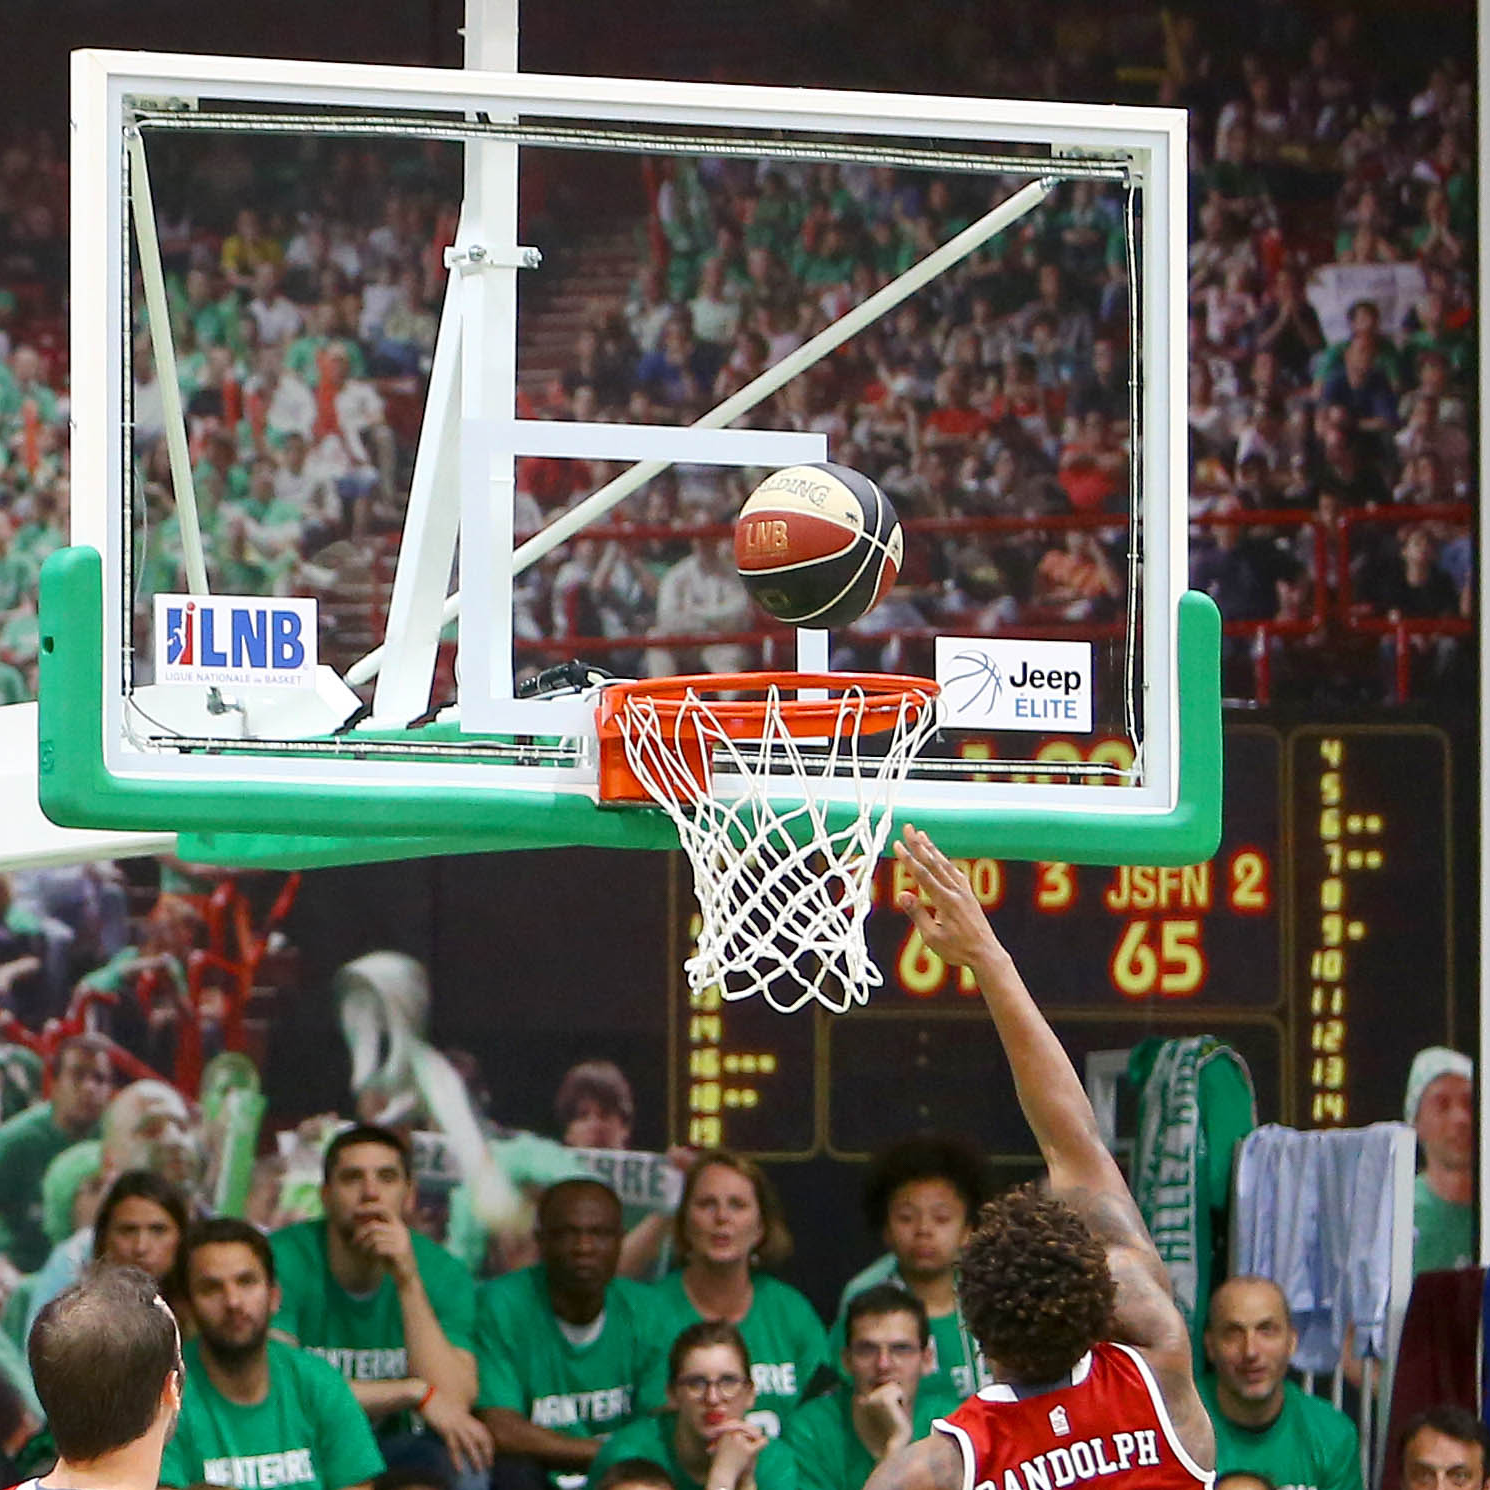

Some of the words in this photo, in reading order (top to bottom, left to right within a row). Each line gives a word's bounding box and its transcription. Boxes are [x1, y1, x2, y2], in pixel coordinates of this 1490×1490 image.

[743, 520, 789, 548] LNB
[197, 672, 250, 684] NATIONALE
[1009, 661, 1082, 696] Jeep
[1037, 861, 1073, 907] 3
[1107, 863, 1209, 909] JSFN
[1231, 852, 1267, 907] 2
[1112, 918, 1204, 995] 65
[1312, 985, 1344, 1017] 11
